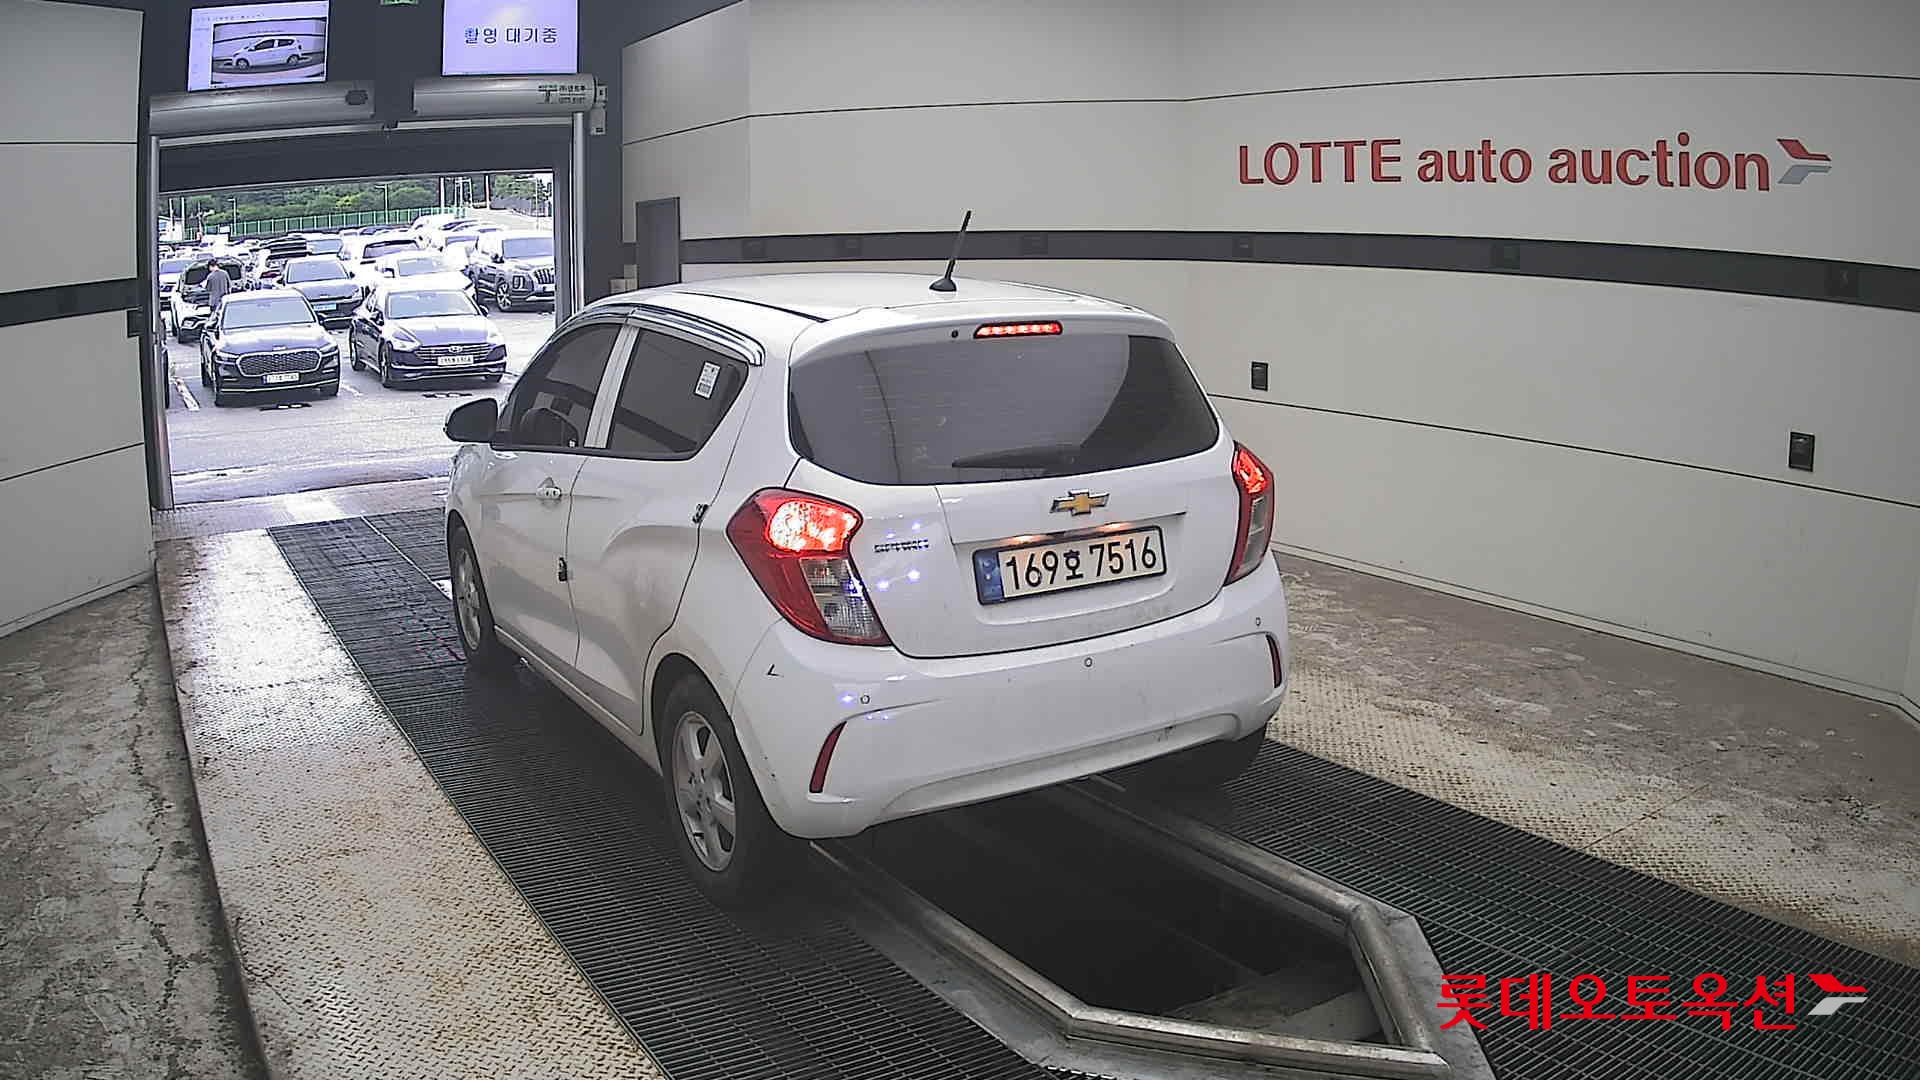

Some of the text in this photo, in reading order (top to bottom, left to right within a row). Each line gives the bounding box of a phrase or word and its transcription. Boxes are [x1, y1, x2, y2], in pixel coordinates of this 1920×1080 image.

[505, 27, 558, 44] 대기중
[1239, 132, 1770, 192] LOTTE auto auction
[1005, 535, 1157, 590] 169호 7516
